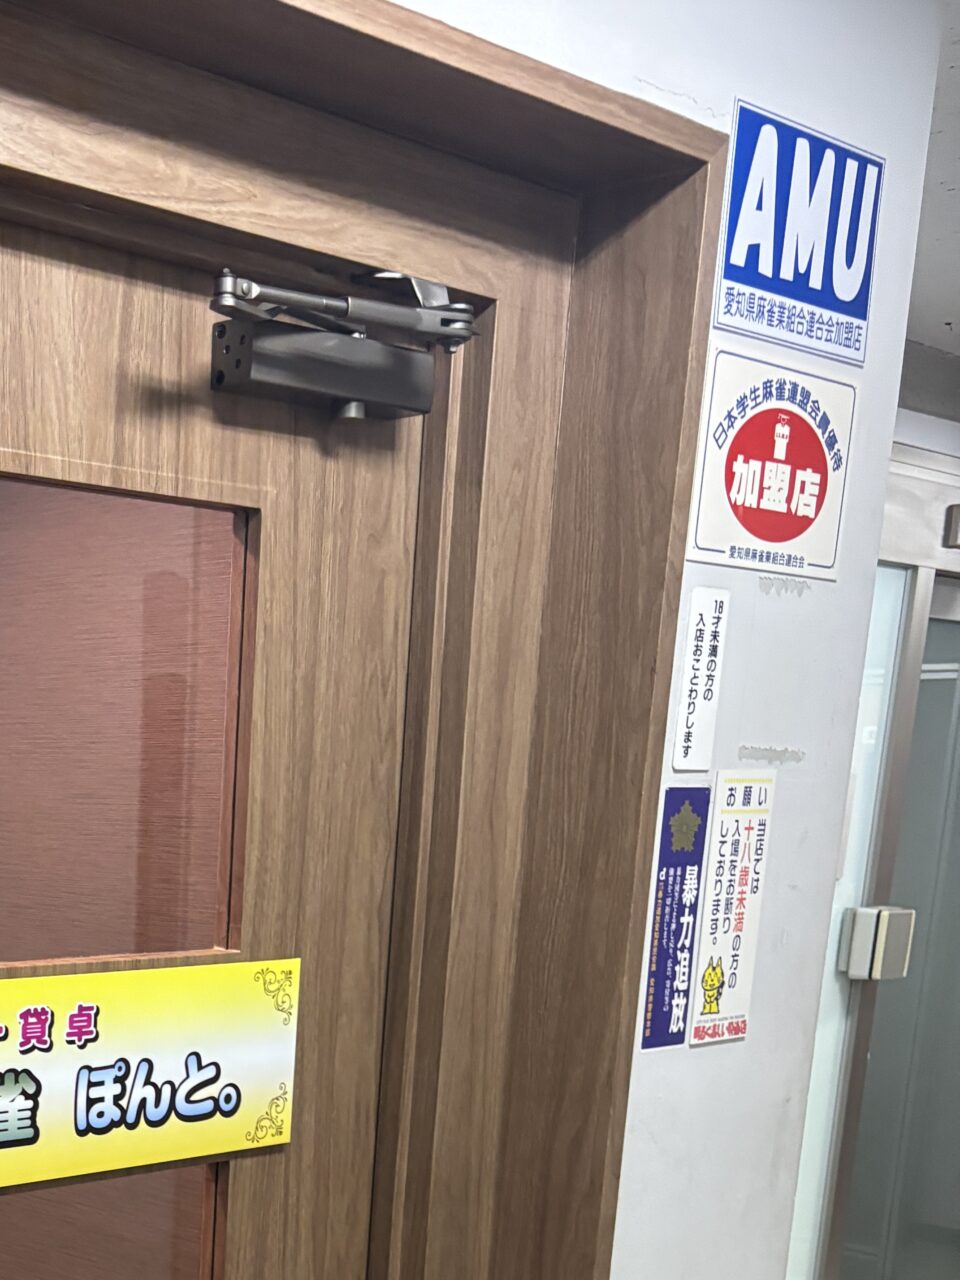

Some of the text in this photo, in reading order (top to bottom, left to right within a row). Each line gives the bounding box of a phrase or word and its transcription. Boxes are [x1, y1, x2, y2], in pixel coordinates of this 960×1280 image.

[729, 123, 879, 302] AMU
[723, 286, 863, 351] 愛知県麻雀業組合連合会加盟店
[713, 378, 843, 472] 日本学生麻雀連盟会員優待
[730, 454, 822, 519] 加盟店
[683, 613, 706, 759] 入店おことわりします
[703, 599, 724, 702] 18才未満の方の
[726, 786, 768, 807] お願い
[709, 820, 729, 946] しております。
[722, 819, 741, 934] 入場をお断り
[728, 818, 755, 989] 十八歳未満の方の
[750, 818, 767, 894] 当店では
[668, 864, 699, 1035] 暴力追放
[73, 1050, 242, 1136] ぽんと。
